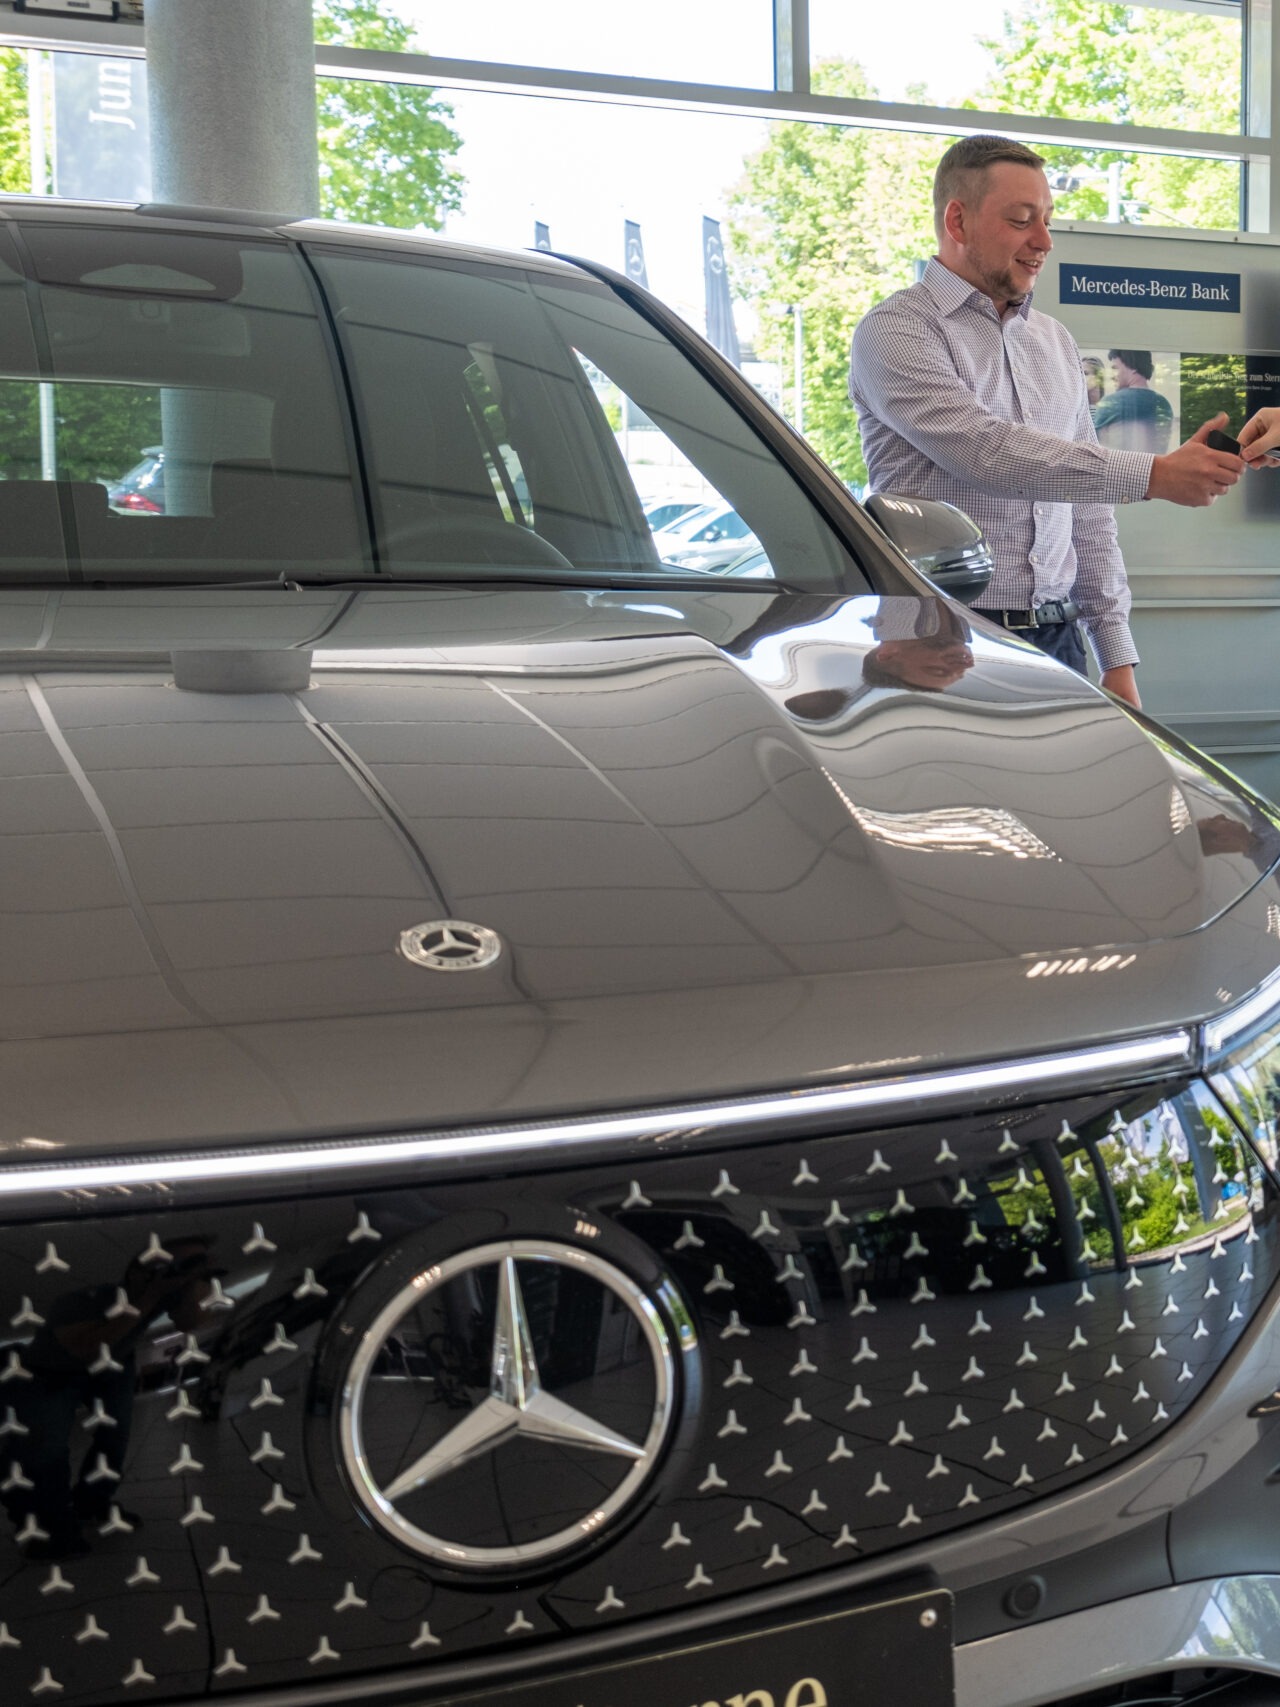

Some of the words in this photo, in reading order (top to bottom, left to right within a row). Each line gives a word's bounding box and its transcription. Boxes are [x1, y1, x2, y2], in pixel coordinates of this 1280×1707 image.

[88, 60, 136, 131] Jun
[1071, 275, 1187, 298] Mercedes-Benz
[1191, 282, 1230, 301] Bank
[1249, 373, 1264, 382] zum
